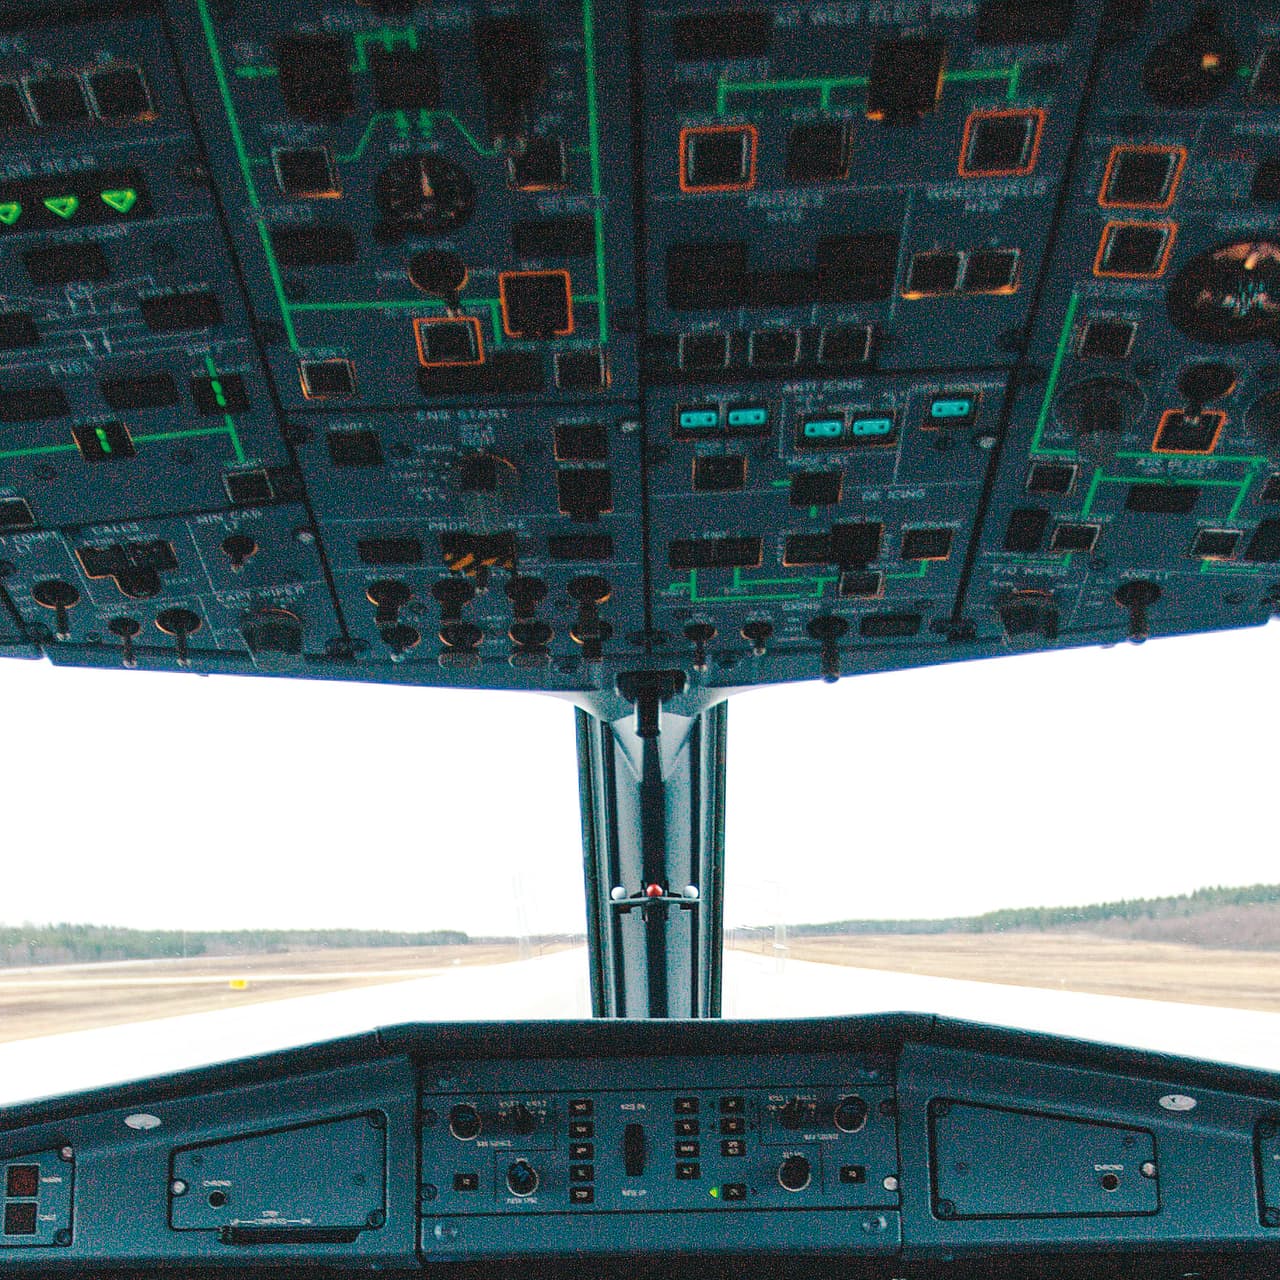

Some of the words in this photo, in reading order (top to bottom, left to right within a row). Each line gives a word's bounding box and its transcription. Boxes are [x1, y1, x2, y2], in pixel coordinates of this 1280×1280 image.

[782, 382, 818, 392] ANTI
[823, 380, 864, 391] ICING
[416, 410, 451, 421] ENG
[457, 409, 509, 420] START
[887, 488, 927, 500] ICING
[91, 522, 140, 536] CALLS
